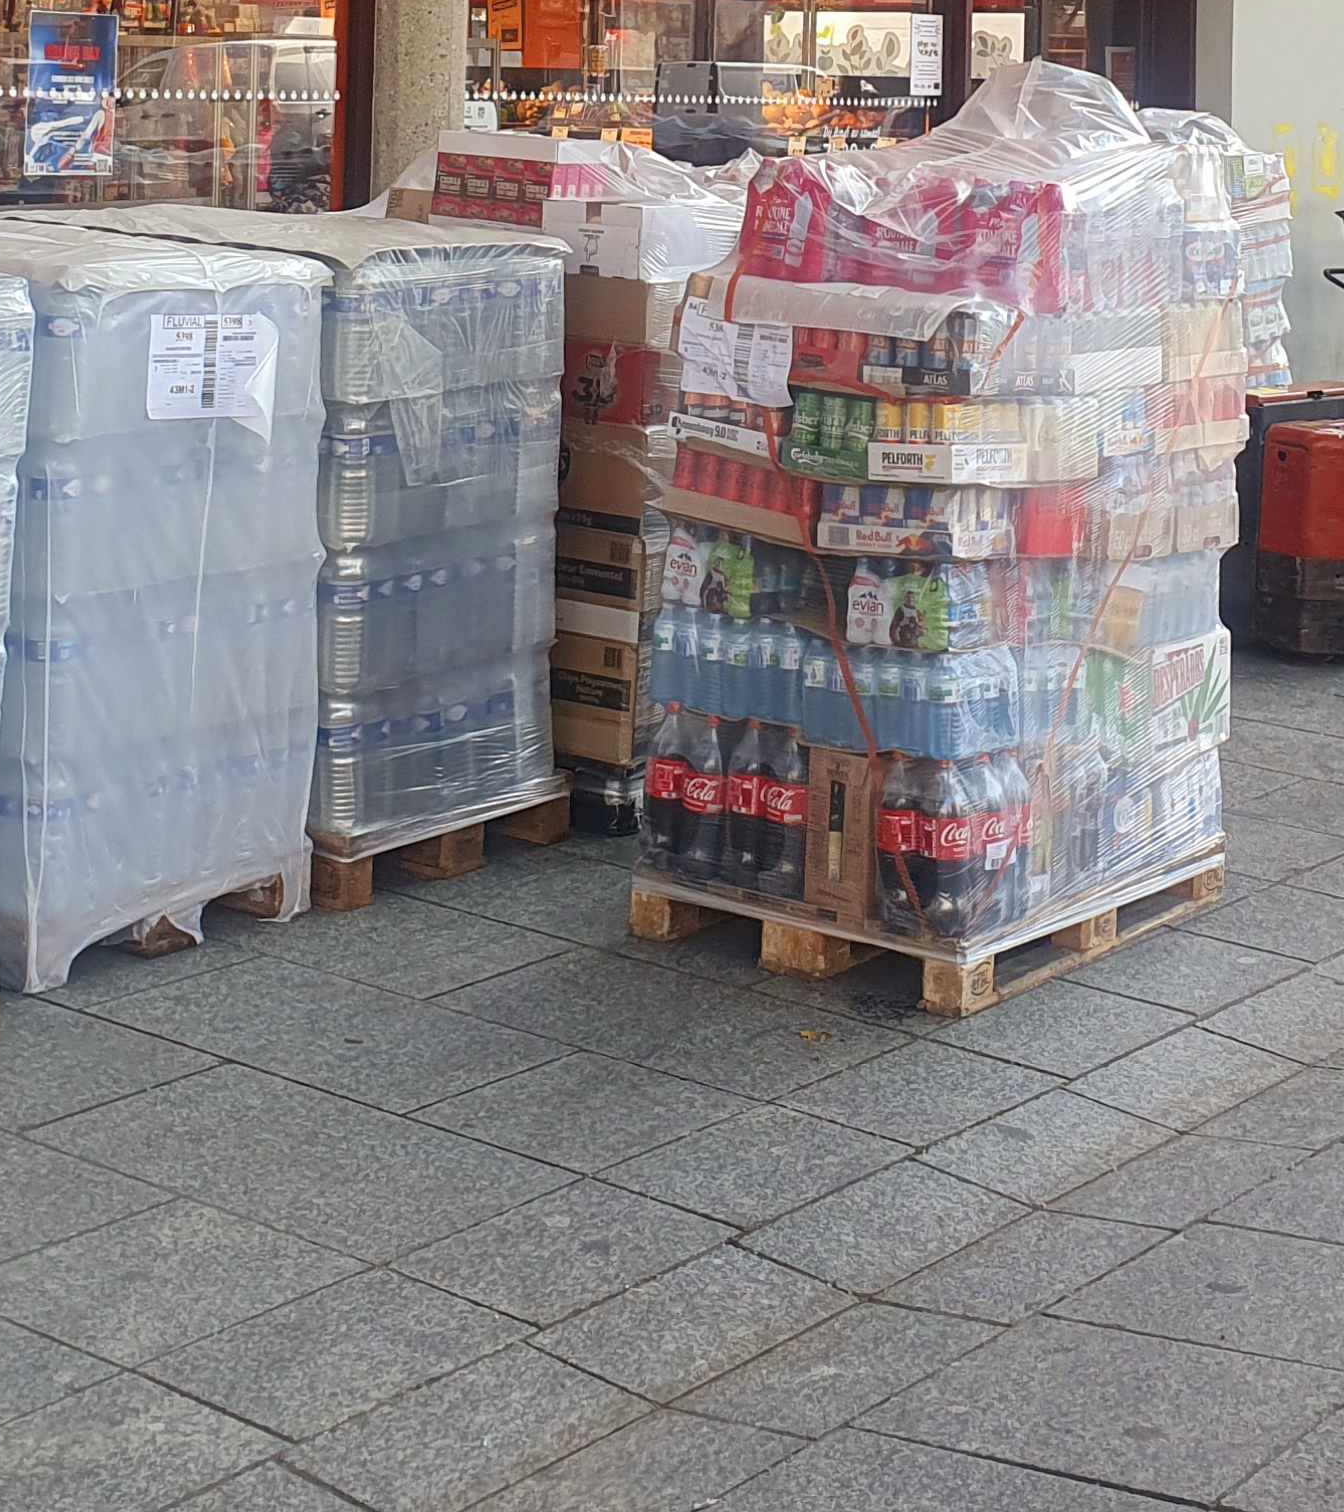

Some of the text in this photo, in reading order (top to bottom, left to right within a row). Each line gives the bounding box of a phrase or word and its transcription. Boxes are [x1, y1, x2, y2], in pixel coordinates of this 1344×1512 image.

[167, 317, 202, 326] FLUVIAL
[923, 374, 948, 386] ATLAS
[1016, 375, 1034, 387] ATLAS
[882, 452, 923, 465] PELFORTH
[856, 530, 892, 542] Red Bull
[670, 558, 697, 576] evian
[852, 599, 884, 617] evian
[686, 778, 719, 801] Cola
